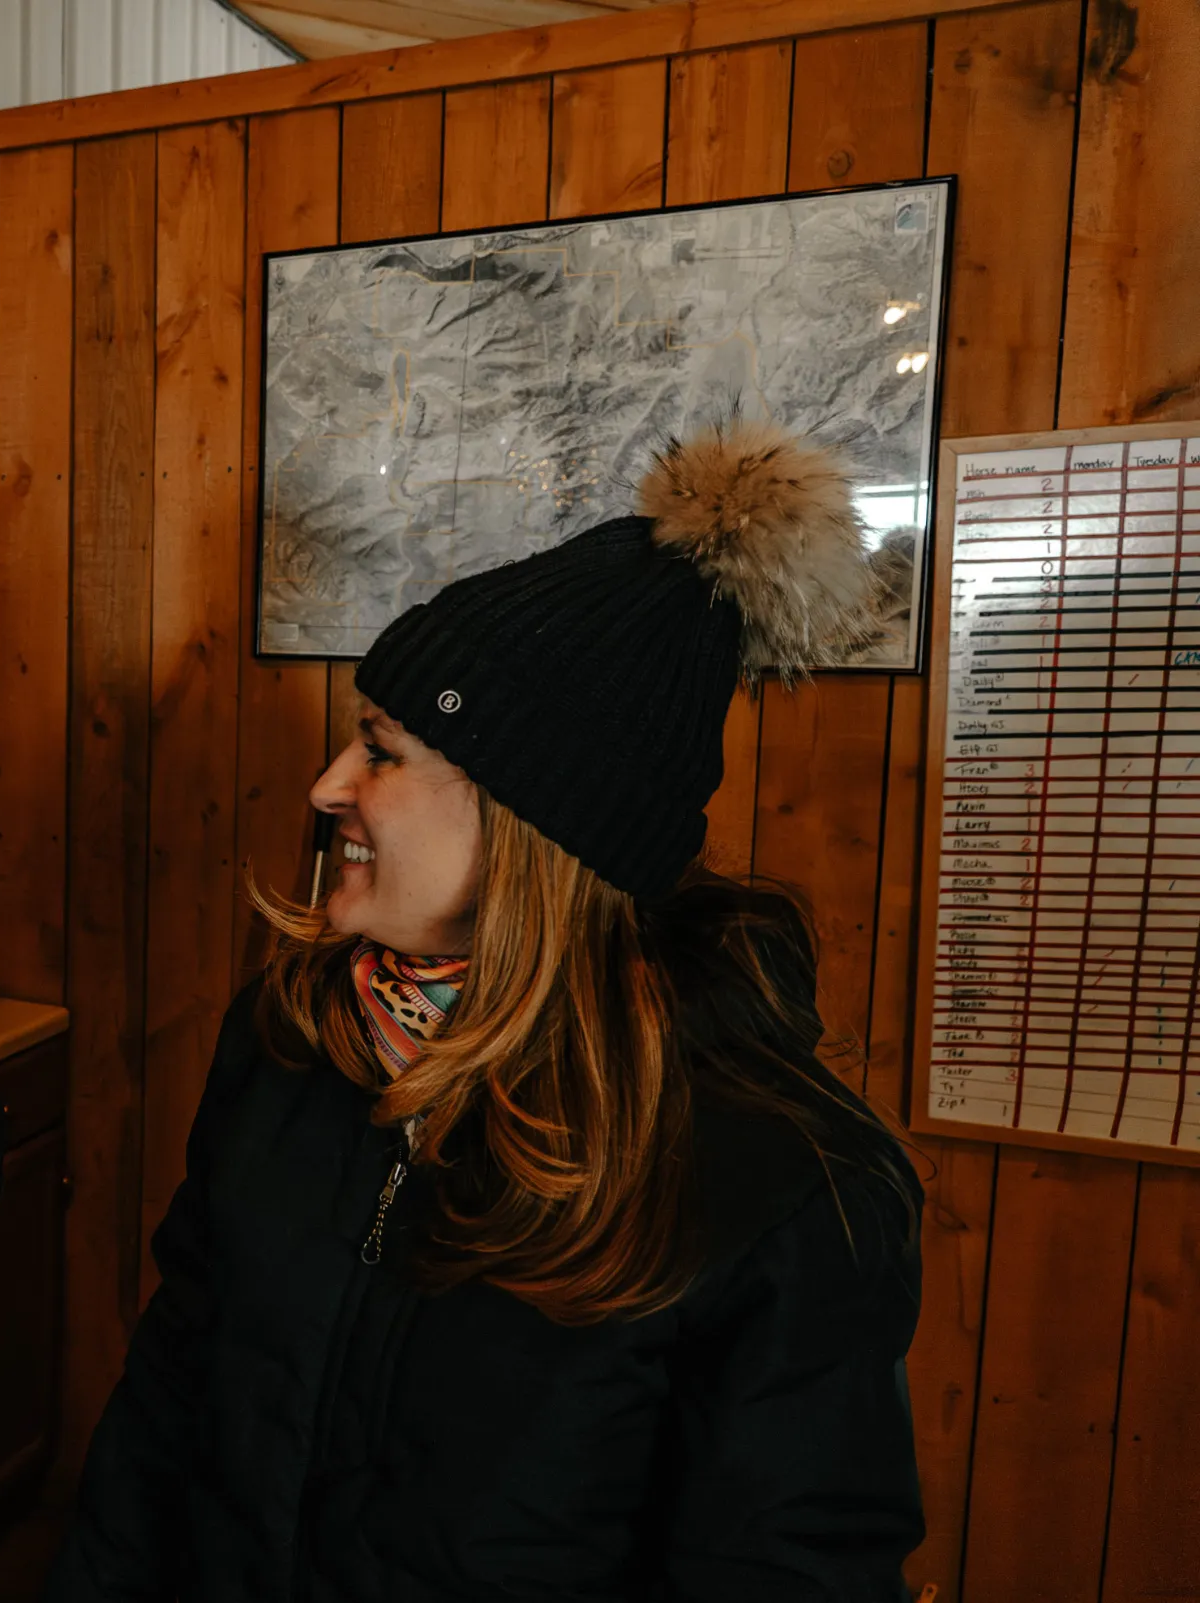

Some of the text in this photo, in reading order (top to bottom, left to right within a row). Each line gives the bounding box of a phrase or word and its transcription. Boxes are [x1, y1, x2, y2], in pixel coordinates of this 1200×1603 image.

[1132, 454, 1175, 467] Tuesday
[965, 463, 1038, 476] Horse name
[1041, 478, 1054, 491] 2
[1042, 501, 1053, 514] 2
[1043, 523, 1053, 534] 2
[1041, 561, 1053, 575] 0
[1039, 616, 1050, 628] 2
[1024, 763, 1034, 777] 3
[955, 818, 990, 832] Larry
[1021, 838, 1032, 852] 2
[1019, 894, 1030, 906] 2
